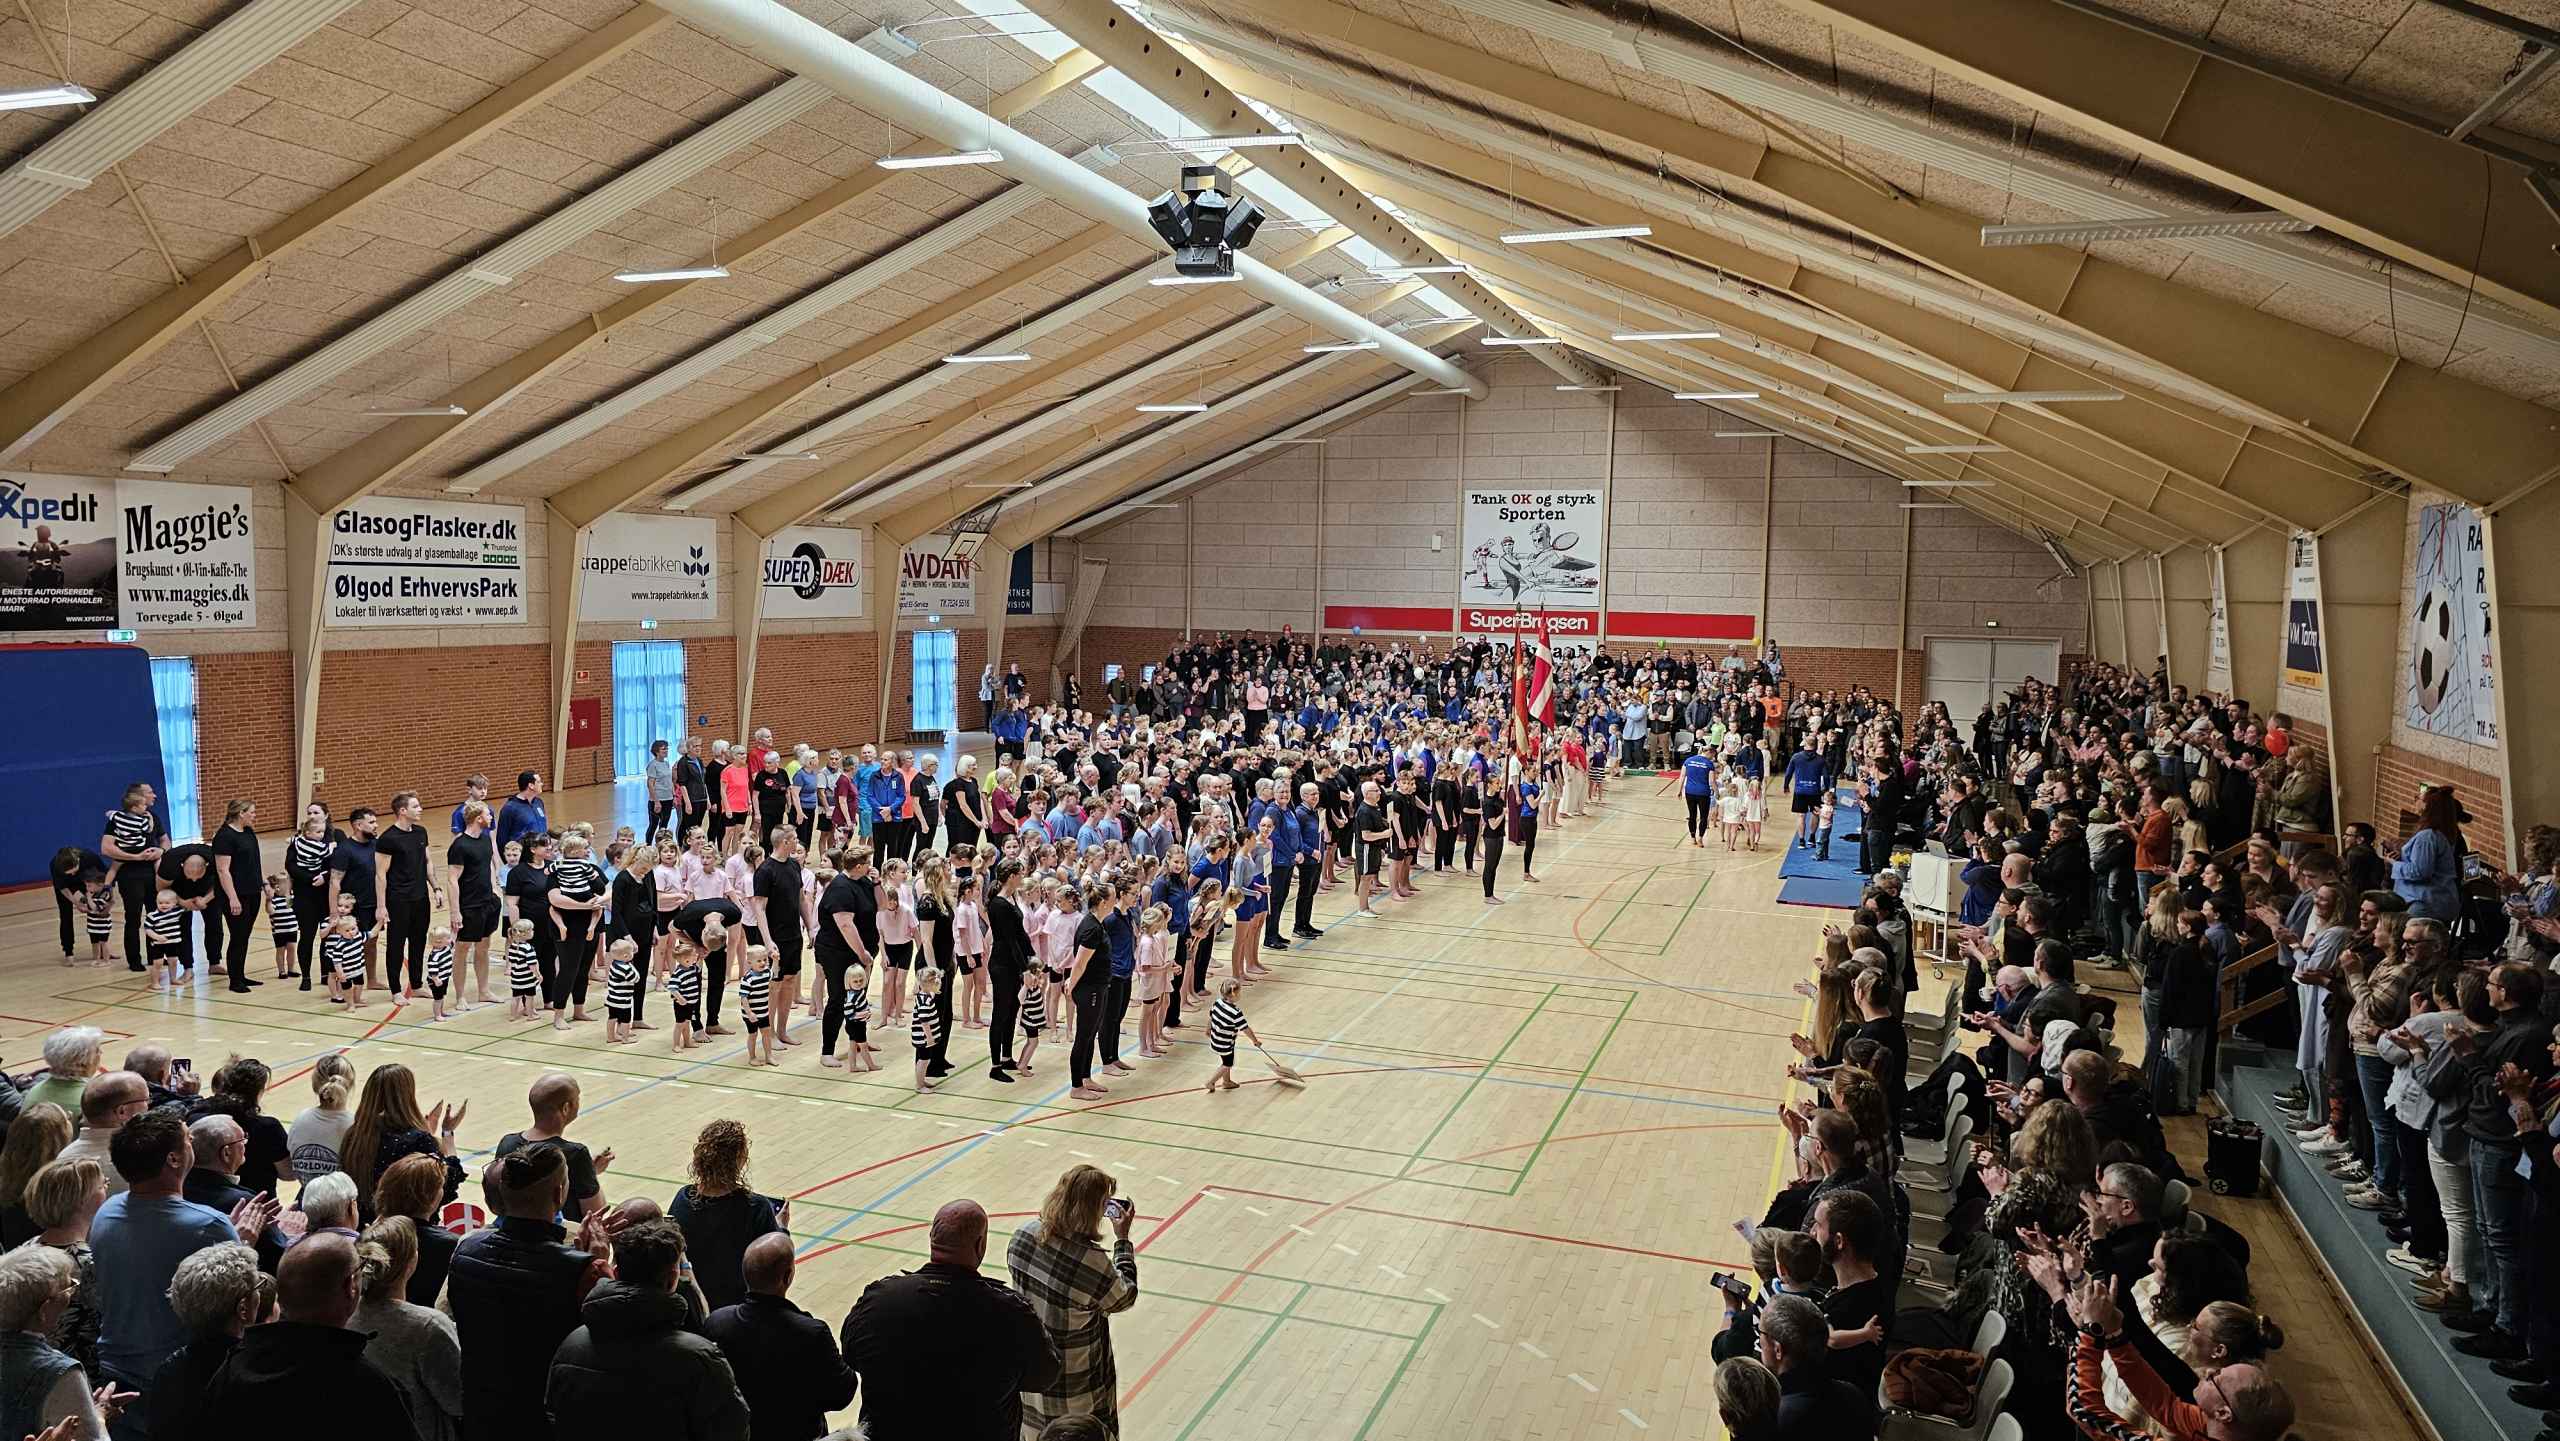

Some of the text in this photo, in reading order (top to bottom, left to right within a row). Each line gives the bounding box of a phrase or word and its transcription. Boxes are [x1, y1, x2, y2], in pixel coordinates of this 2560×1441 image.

[1472, 493, 1596, 507] Tank OK og styrk
[1499, 508, 1566, 522] Sporten
[124, 504, 249, 555] Maggie's
[334, 510, 517, 542] GlasogFlasker.dk
[334, 544, 479, 561] DK's største udvalg af glasemballage
[125, 561, 248, 580] Brugskunst Øl-Vin-Kaffe-The
[581, 555, 682, 574] trappefabrikken
[763, 559, 855, 584] SUPER DÆK
[2, 588, 94, 596] ENESTE AUTORISEREDE
[128, 584, 249, 607] www.maggies.dk
[335, 574, 518, 602] Ølgod ErhvervsPark
[631, 591, 709, 602] www.trappefabrikken.dk
[136, 612, 193, 624] Torvegade
[196, 611, 203, 621] 5
[213, 610, 243, 623] Ølgod
[335, 606, 367, 617] Lokaler
[368, 605, 377, 616] til
[378, 605, 428, 617] iværksætteri
[429, 607, 439, 618] og
[441, 605, 463, 616] vækst
